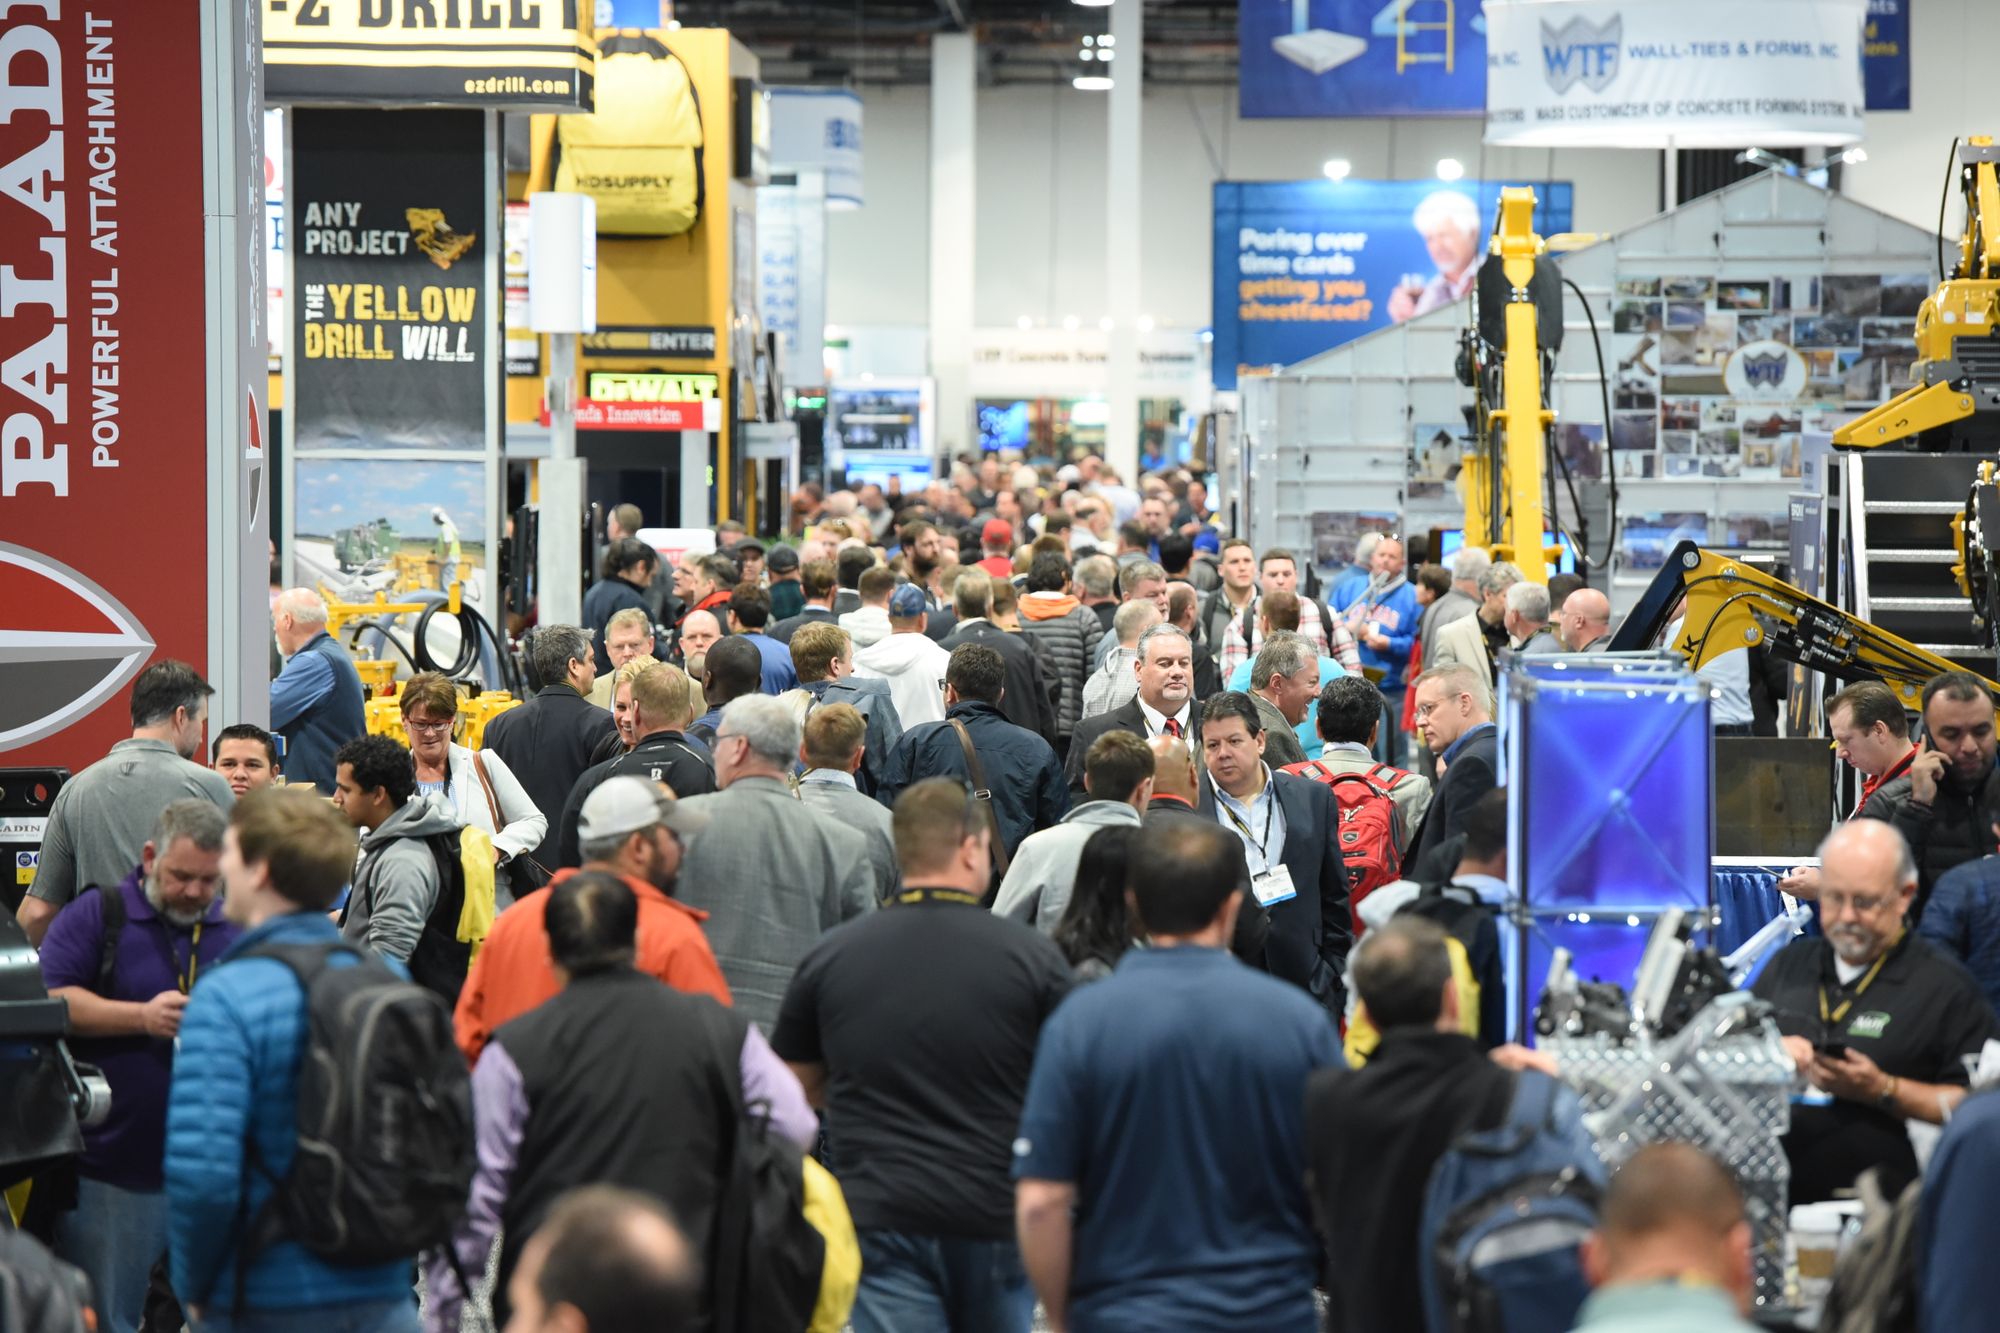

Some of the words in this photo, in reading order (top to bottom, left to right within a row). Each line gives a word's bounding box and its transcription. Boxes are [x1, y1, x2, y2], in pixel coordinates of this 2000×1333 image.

[1543, 43, 1618, 77] WTF
[1628, 42, 1730, 58] WALL-TIES
[1737, 43, 1749, 57] &
[465, 76, 570, 95] ezdrill.com
[1654, 101, 1671, 116] OF
[1676, 100, 1750, 116] CONCRETE
[85, 12, 118, 257] ATTACHMENT
[304, 202, 362, 227] ANY
[304, 230, 410, 255] PROJECT
[305, 284, 325, 321] THE
[327, 284, 477, 323] YELLOW
[304, 323, 395, 360] DRILL
[402, 325, 475, 362] WILL
[650, 332, 715, 351] ENTER
[91, 268, 119, 468] POWERFUL
[606, 404, 683, 424] Innovation
[0, 825, 41, 833] ADIN
